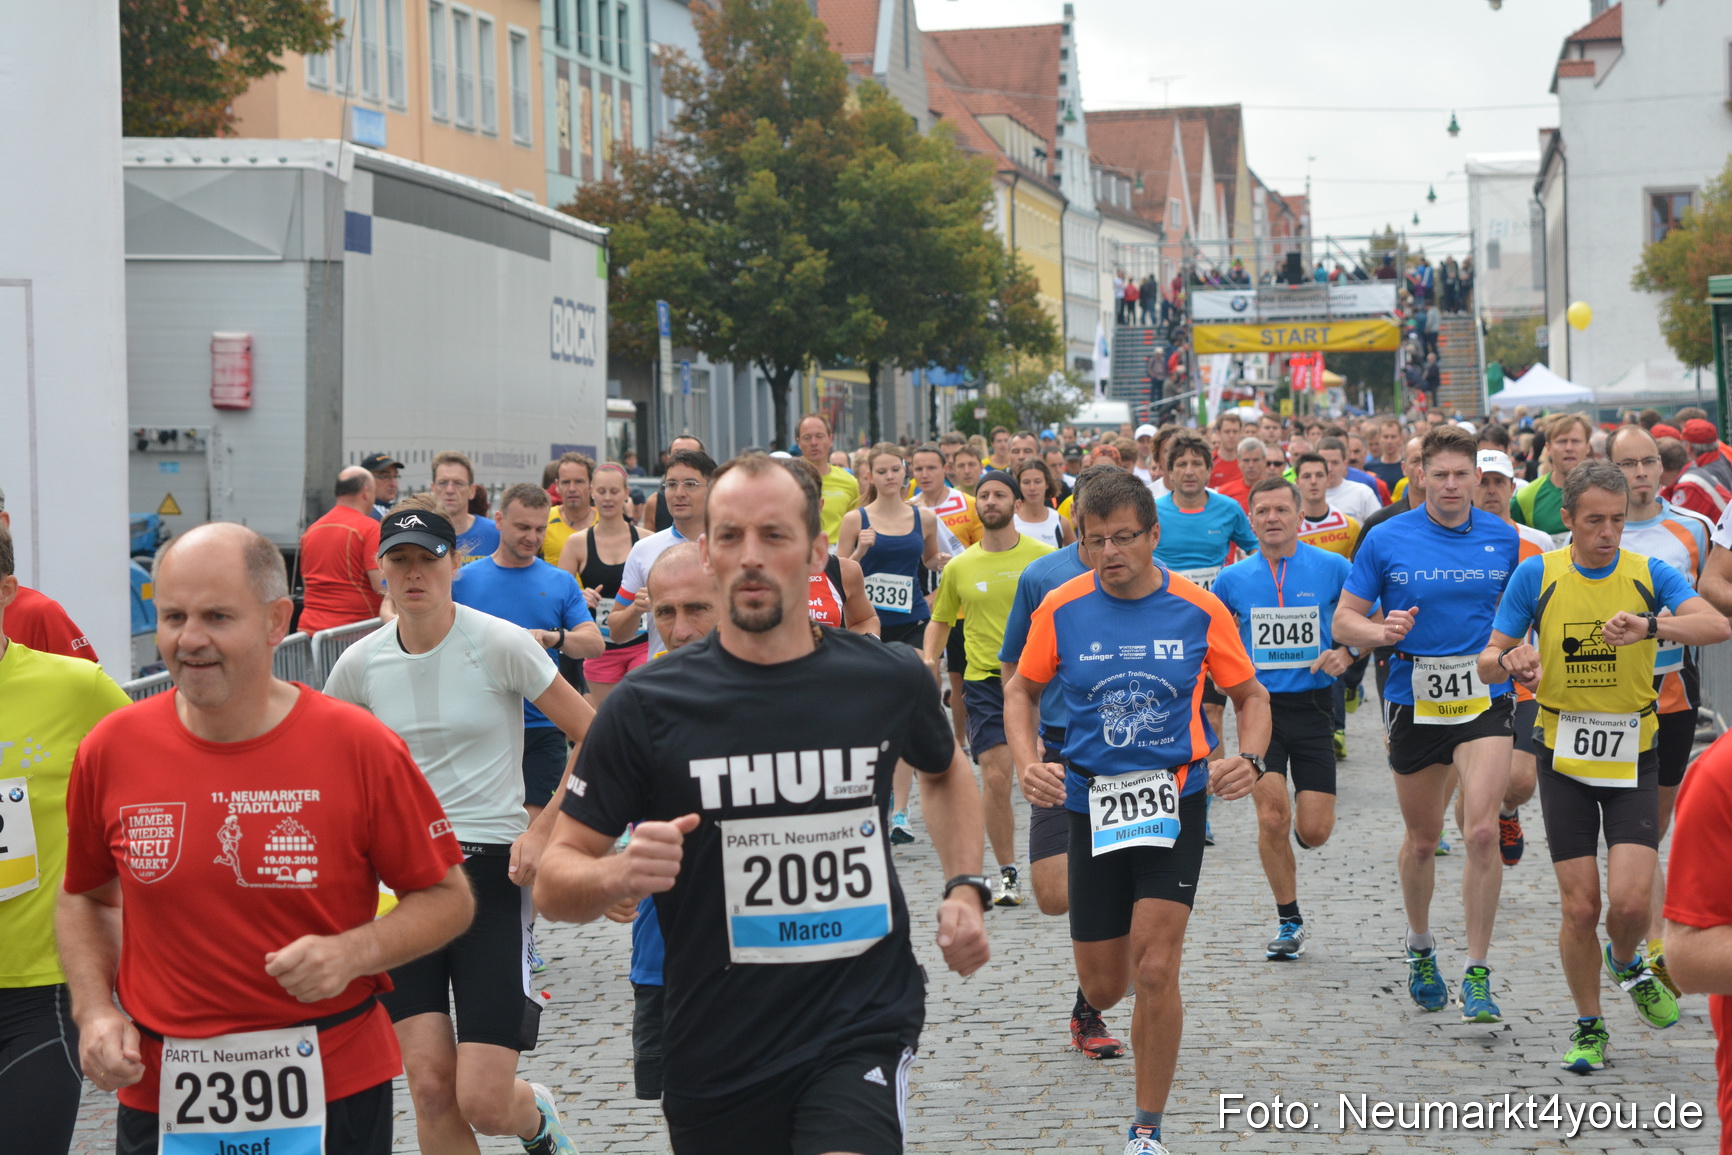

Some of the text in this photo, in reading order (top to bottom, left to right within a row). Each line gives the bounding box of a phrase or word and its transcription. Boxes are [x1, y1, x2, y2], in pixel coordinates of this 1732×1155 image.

[551, 297, 596, 366] BOCK
[1260, 328, 1331, 346] START
[1320, 533, 1350, 544] BÖGL
[1390, 572, 1408, 584] sg
[1415, 568, 1484, 582] ruhrgas
[808, 597, 823, 606] ort
[865, 585, 908, 606] 3339
[808, 608, 828, 619] ller
[1258, 622, 1314, 645] 2048
[1079, 653, 1114, 662] Ensinger
[1268, 650, 1304, 660] Michael
[1414, 660, 1474, 671] PARTL Neumarkt
[1566, 663, 1616, 674] HIRSCH
[1091, 672, 1126, 693] Heilbronner
[1427, 671, 1473, 699] 341
[1438, 705, 1468, 715] Oliver
[1560, 714, 1627, 727] PARTL Neumarkt
[1160, 736, 1175, 744] 2014
[1573, 728, 1625, 757] 607
[566, 774, 587, 797] ULE
[689, 747, 879, 810] THULE
[1091, 772, 1165, 794] PARTL Neumarkt
[211, 790, 320, 803] 11. NEUMARKTER
[833, 784, 869, 794] SWEDEN
[228, 802, 303, 814] STADTLAUF
[1100, 783, 1175, 826] 2036
[128, 814, 173, 828] IMMER
[128, 827, 174, 840] WIEDER
[727, 827, 854, 848] PARTL Neumarkt
[1115, 821, 1164, 841] Michael
[129, 840, 170, 857] NEU
[130, 858, 168, 869] MARKT
[263, 856, 318, 865] 19.09.2010
[743, 846, 872, 907] 2095
[779, 920, 842, 942] Marco
[165, 1045, 290, 1063] PARTL Neumarkt
[175, 1065, 308, 1125] 2390
[215, 1137, 271, 1155] Josef
